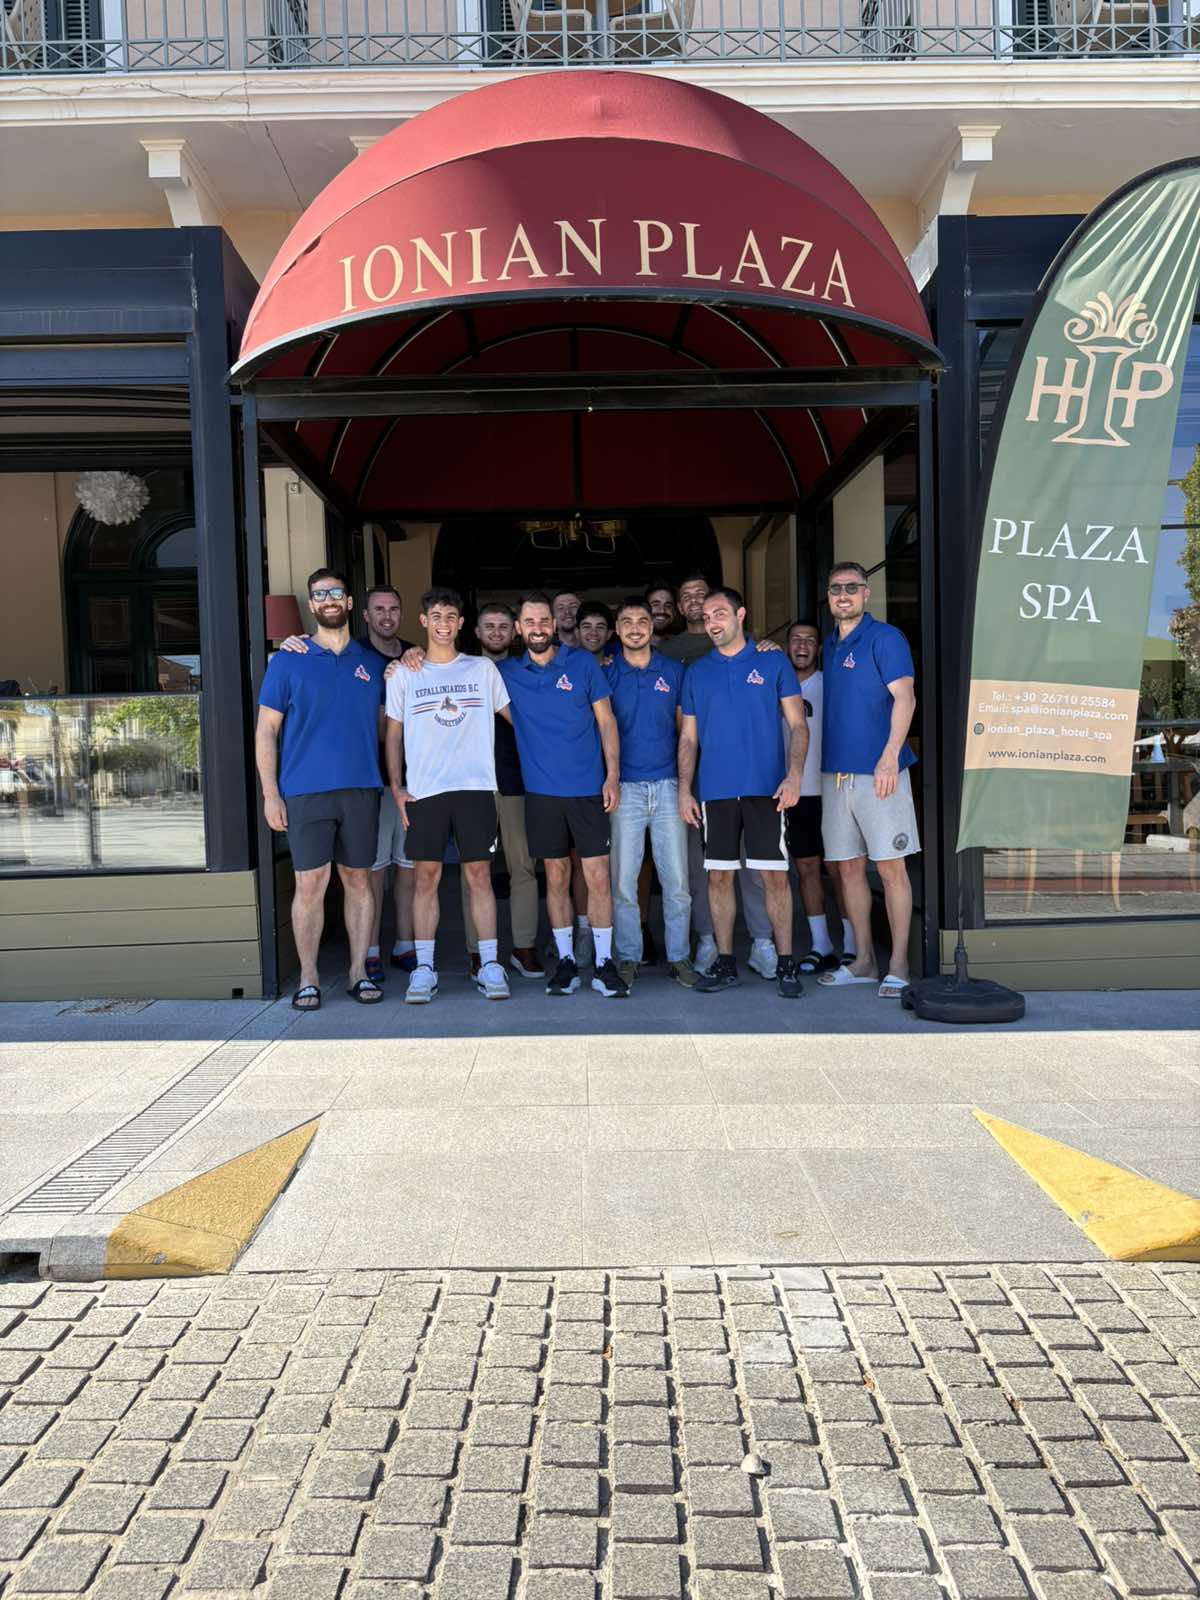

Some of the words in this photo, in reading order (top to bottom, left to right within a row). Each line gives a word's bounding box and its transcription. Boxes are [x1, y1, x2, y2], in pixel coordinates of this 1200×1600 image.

[338, 218, 606, 313] IONIAN
[633, 219, 856, 308] PLAZA
[988, 517, 1149, 564] PLAZA
[1019, 582, 1102, 624] SPA
[1014, 691, 1036, 702] +30
[1041, 693, 1078, 705] 26710
[1080, 696, 1116, 709] 25584
[978, 702, 1009, 713] Email:
[1010, 704, 1129, 721] spa@ionianplaza.com
[987, 723, 1113, 741] ionian_plaza_hotel_spa
[988, 748, 1107, 764] www.ionianplaza.com
